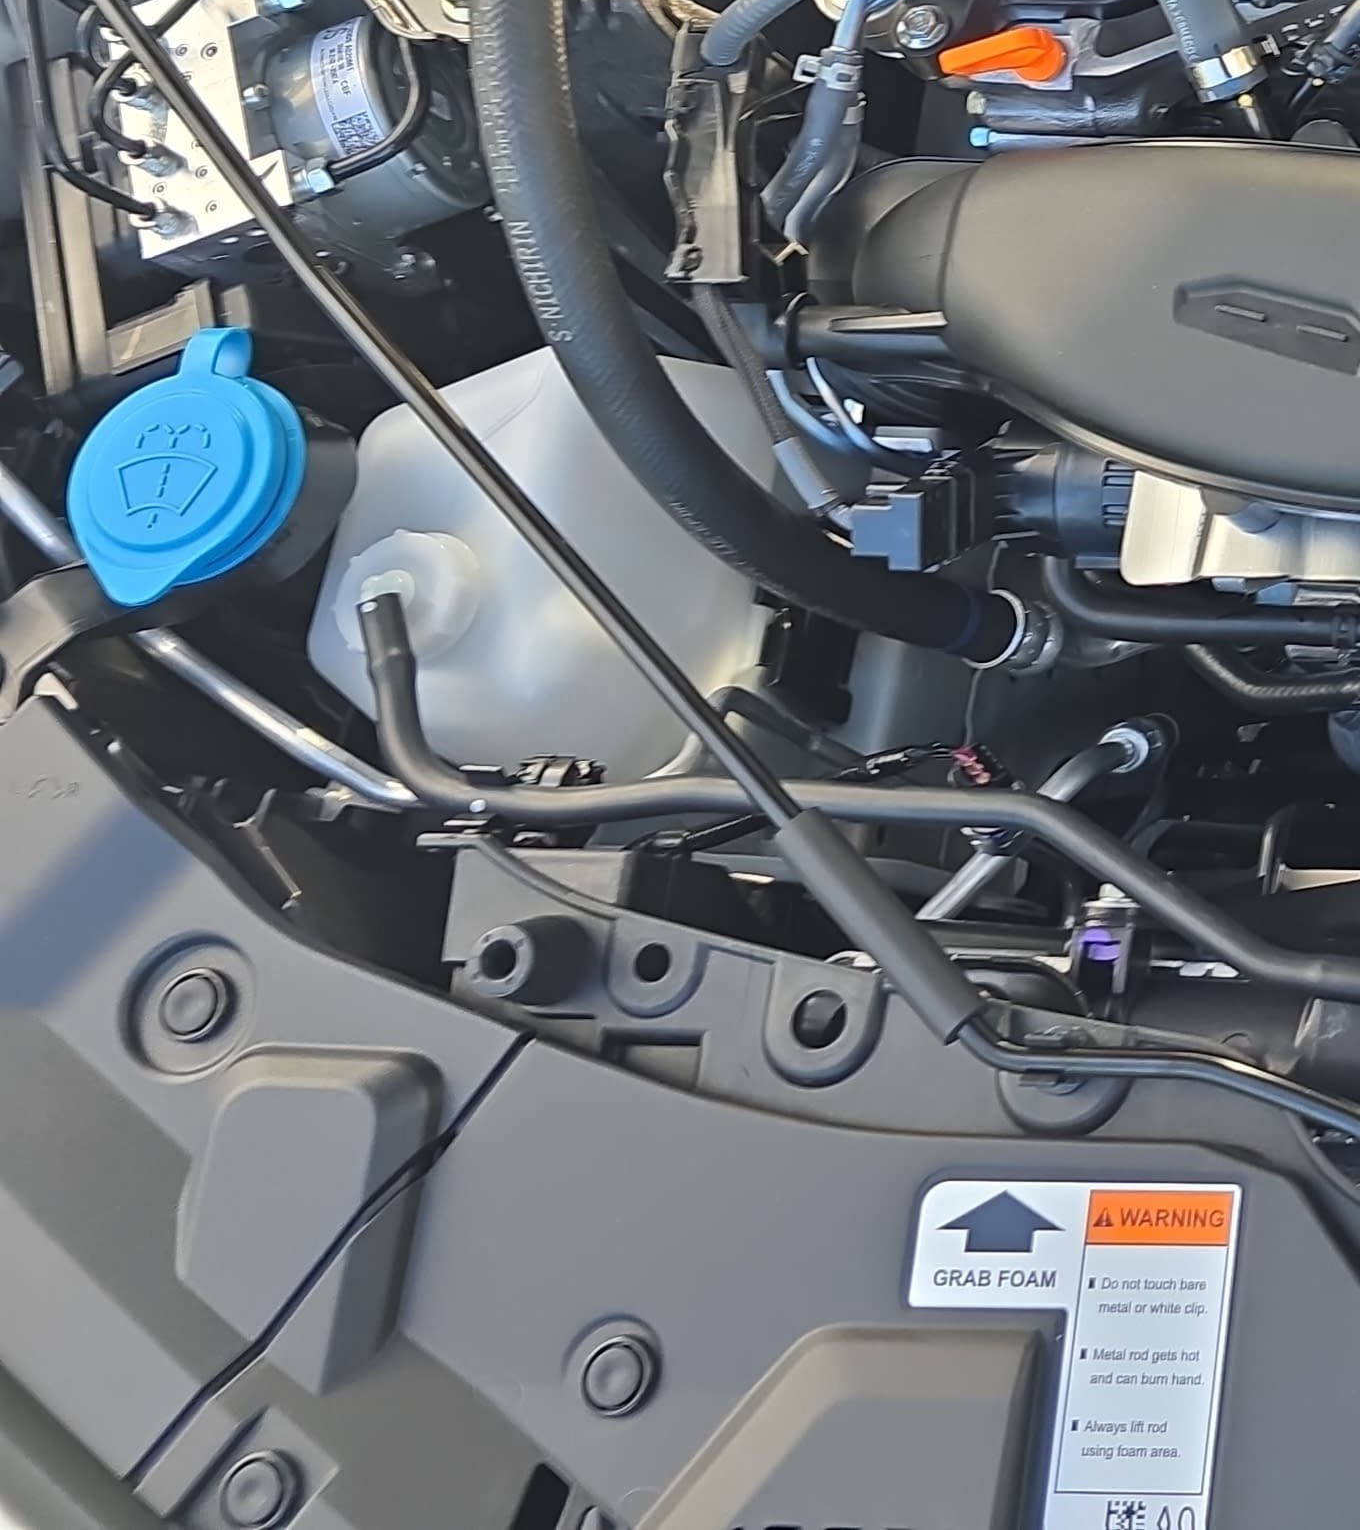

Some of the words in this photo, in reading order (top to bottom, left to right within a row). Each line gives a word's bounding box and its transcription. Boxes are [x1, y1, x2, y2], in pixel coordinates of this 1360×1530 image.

[1119, 1208, 1225, 1228] WARNING
[933, 1269, 991, 1288] GRAB
[997, 1270, 1057, 1288] FOAM
[1101, 1278, 1118, 1290] Do
[1121, 1279, 1141, 1290] not
[1144, 1278, 1177, 1291] touch
[1180, 1279, 1207, 1291] bare
[1098, 1302, 1131, 1314] metal
[1134, 1305, 1147, 1314] or
[1149, 1302, 1182, 1315] white
[1184, 1302, 1208, 1317] clip.
[1092, 1348, 1126, 1362] Metal
[1129, 1349, 1149, 1361] rod
[1151, 1350, 1178, 1365] gets
[1181, 1350, 1200, 1362] hot
[1089, 1373, 1112, 1386] and
[1116, 1375, 1138, 1386] can
[1141, 1373, 1169, 1386] burn
[1171, 1373, 1205, 1387] hand.
[1083, 1420, 1127, 1435] Always
[1130, 1420, 1145, 1434] lift
[1147, 1420, 1167, 1434] rod
[1081, 1446, 1113, 1460] using
[1116, 1445, 1147, 1459] foam
[1149, 1448, 1181, 1459] area.
